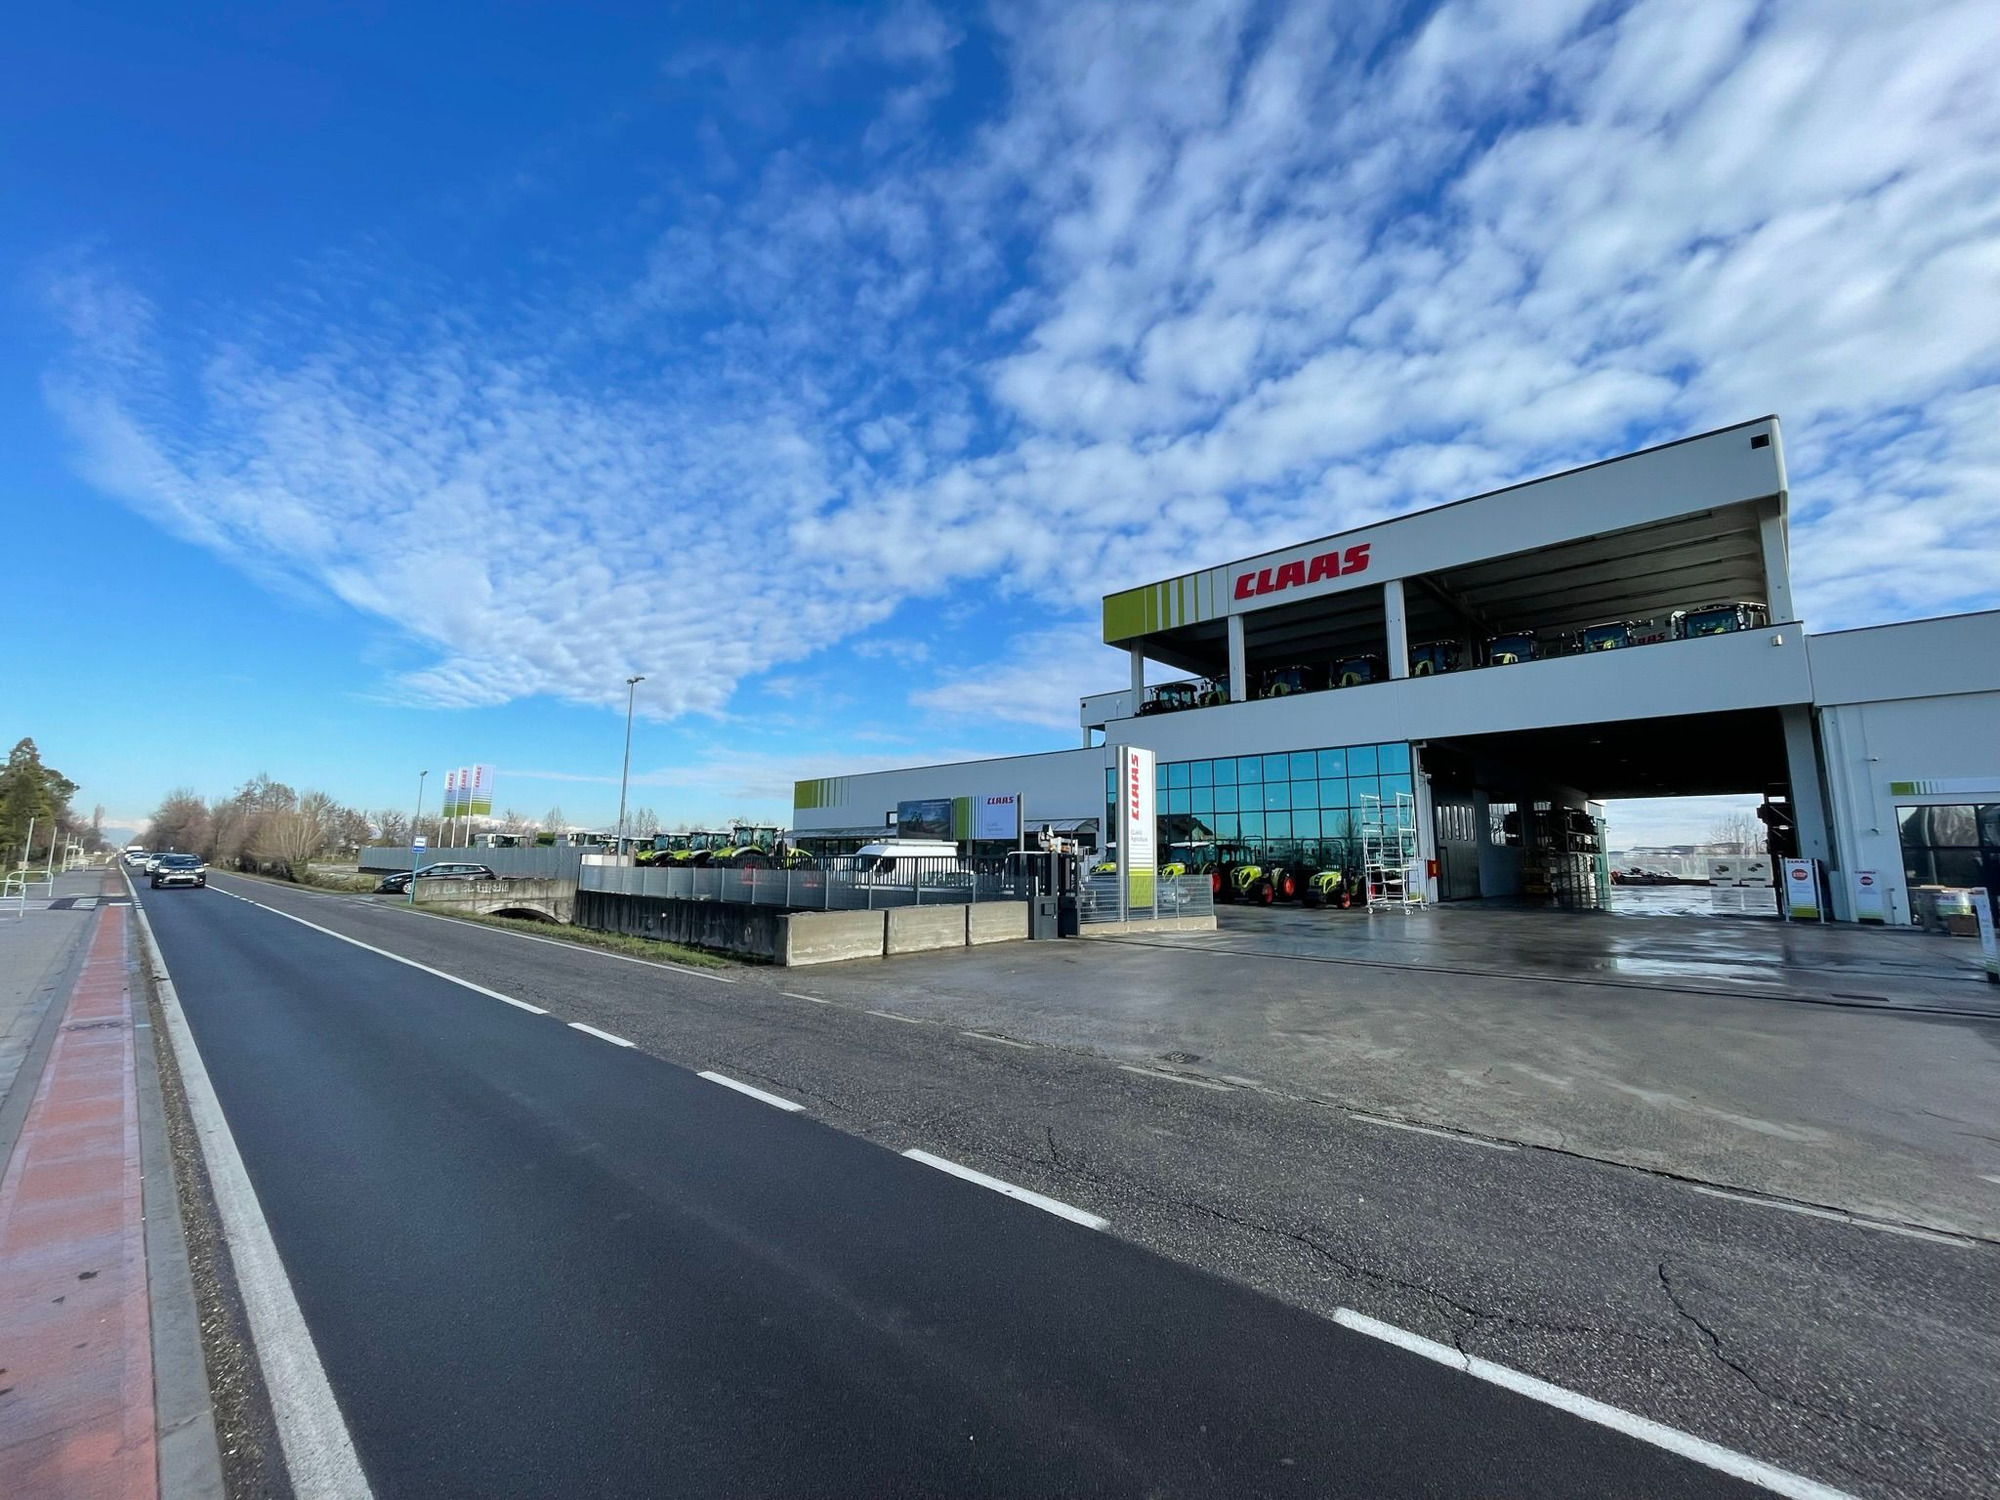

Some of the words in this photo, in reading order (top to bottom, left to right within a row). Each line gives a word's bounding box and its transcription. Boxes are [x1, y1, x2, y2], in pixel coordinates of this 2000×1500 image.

[1234, 543, 1371, 600] CLAAS
[987, 796, 1014, 805] CLAAS
[1131, 753, 1140, 820] CLAAS
